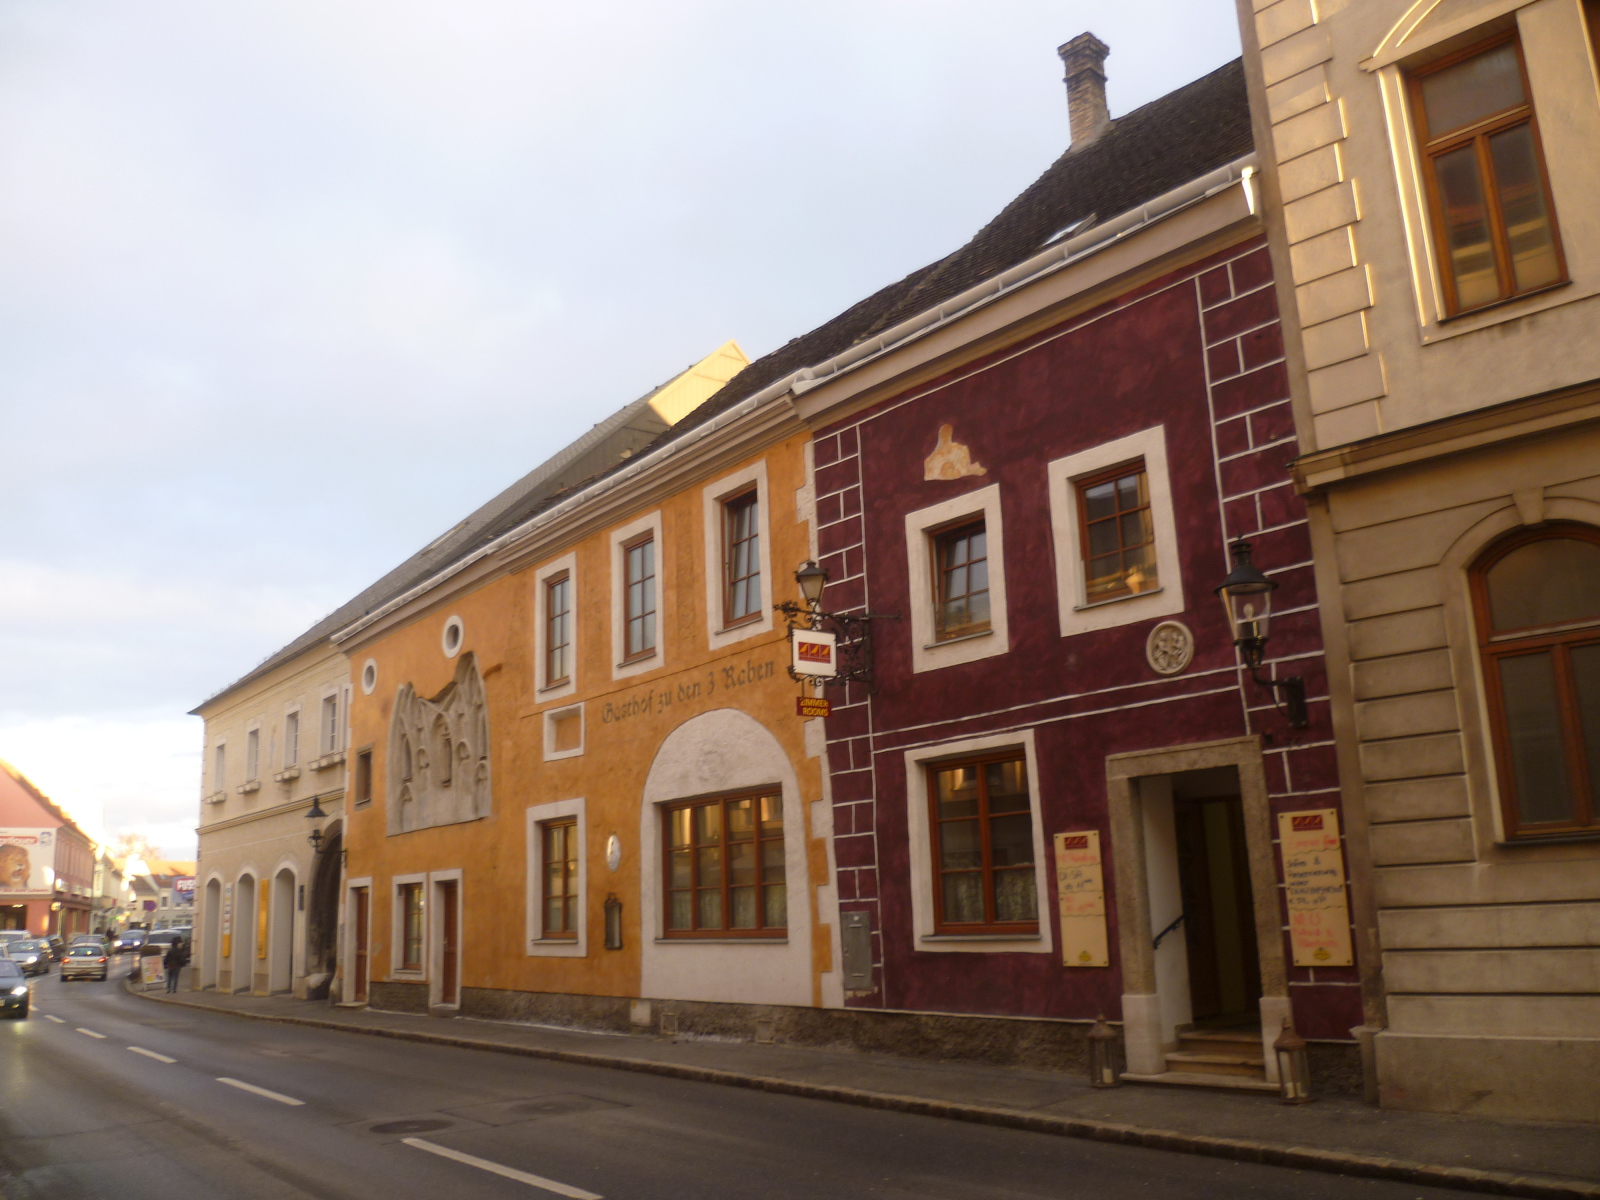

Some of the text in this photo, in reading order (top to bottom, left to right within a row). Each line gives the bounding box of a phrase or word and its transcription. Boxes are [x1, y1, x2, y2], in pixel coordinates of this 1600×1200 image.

[602, 660, 774, 724] Gasthof zu den 3 Raben
[800, 698, 830, 708] ZIMMER
[802, 707, 829, 717] ROOMS
